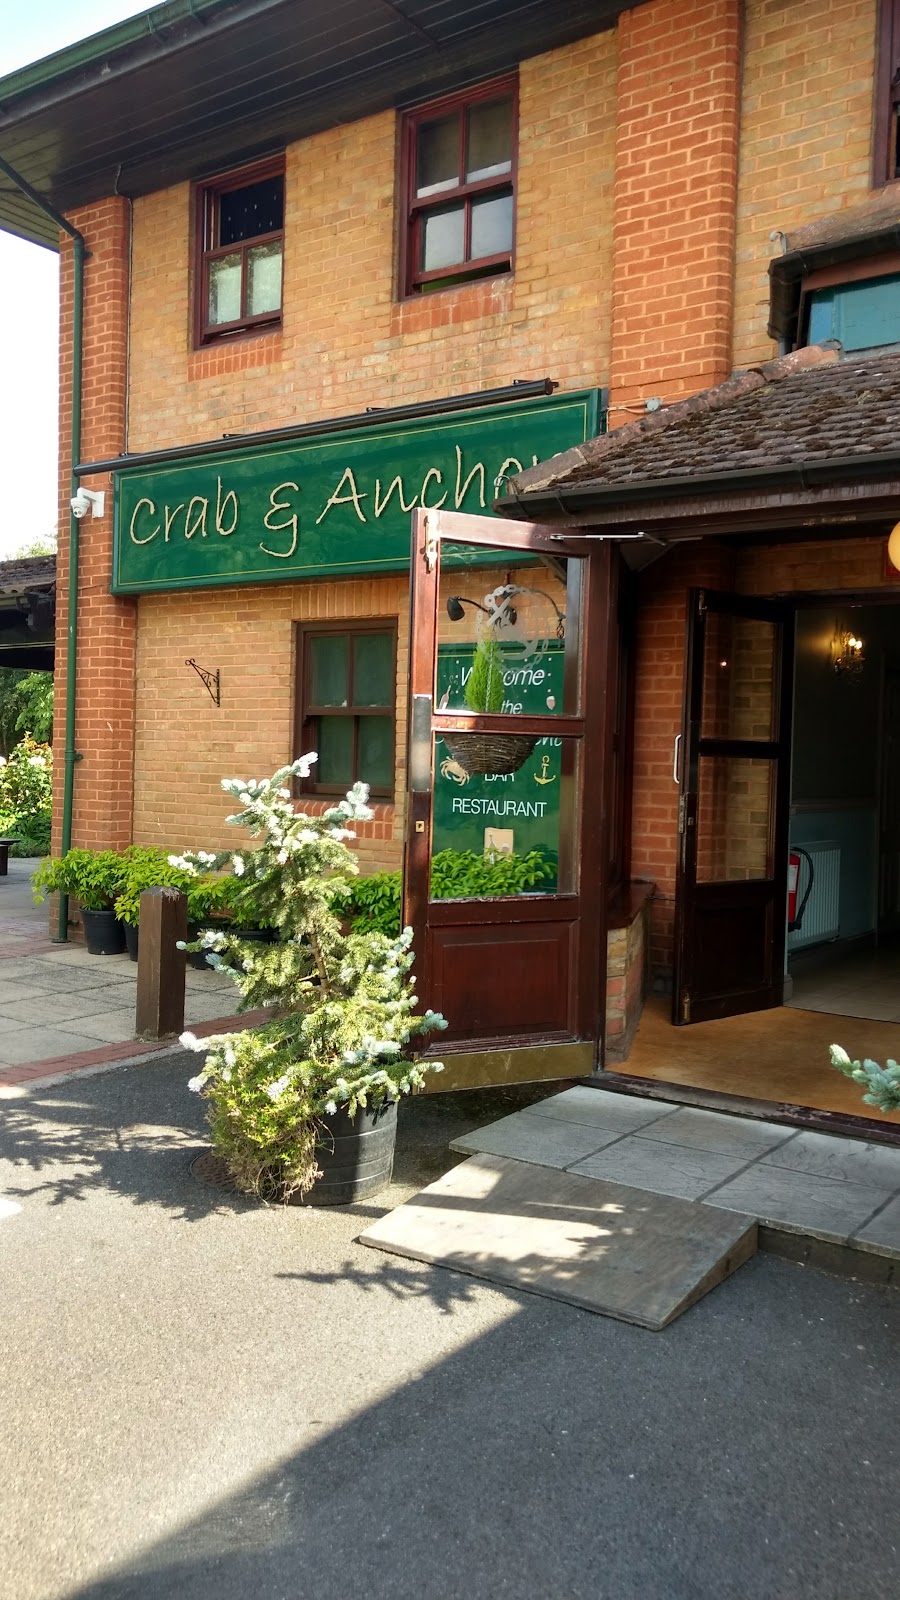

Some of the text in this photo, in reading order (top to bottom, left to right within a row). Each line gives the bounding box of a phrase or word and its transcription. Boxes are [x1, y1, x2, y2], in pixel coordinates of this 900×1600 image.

[130, 445, 561, 558] Crab & Ancho
[501, 700, 523, 714] the
[452, 798, 547, 817] RESTAURANT
